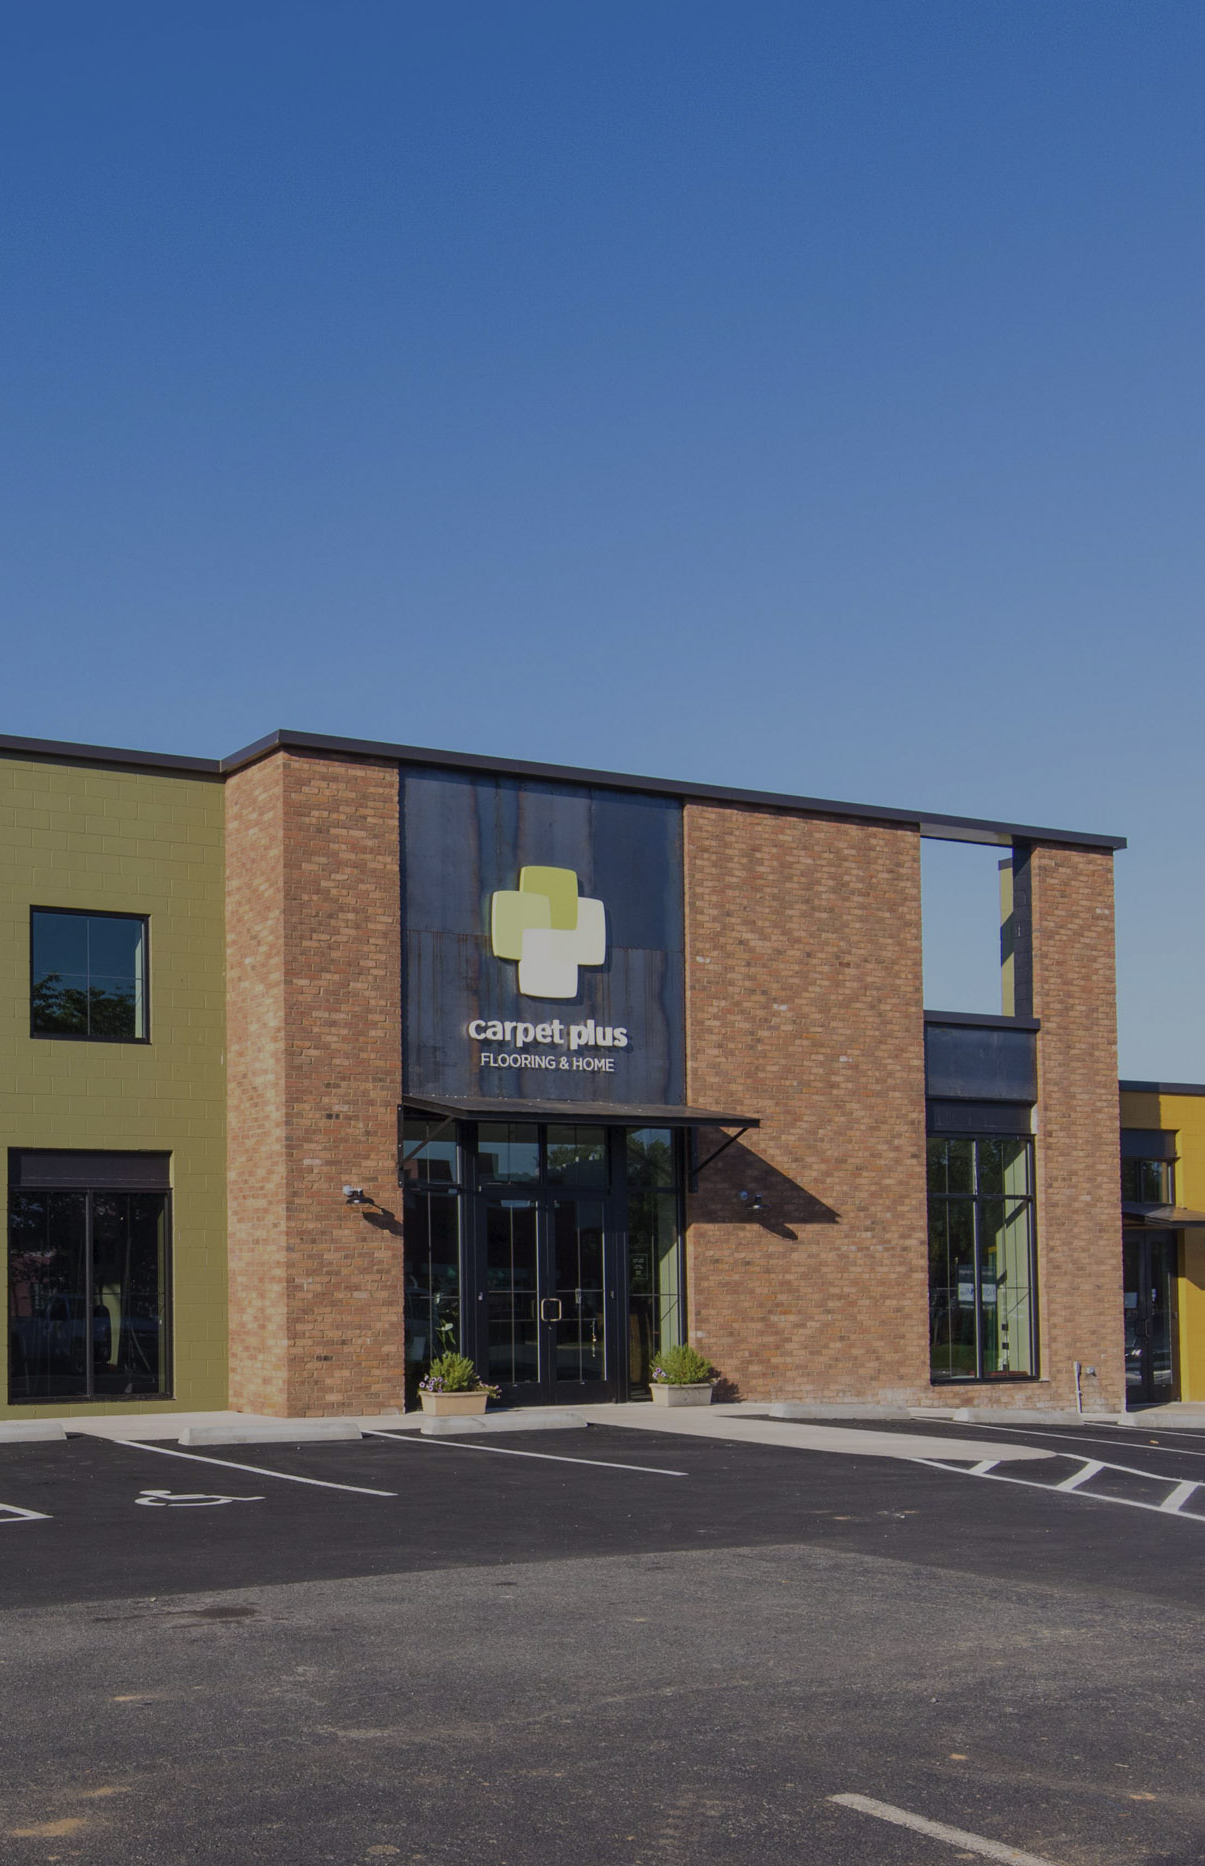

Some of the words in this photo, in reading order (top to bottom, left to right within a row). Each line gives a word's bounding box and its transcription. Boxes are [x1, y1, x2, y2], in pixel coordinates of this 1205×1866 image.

[468, 1019, 564, 1048] carpet
[569, 1019, 629, 1050] plus
[480, 1052, 556, 1069] FLOORING
[560, 1056, 570, 1070] &
[573, 1056, 615, 1072] HOME
